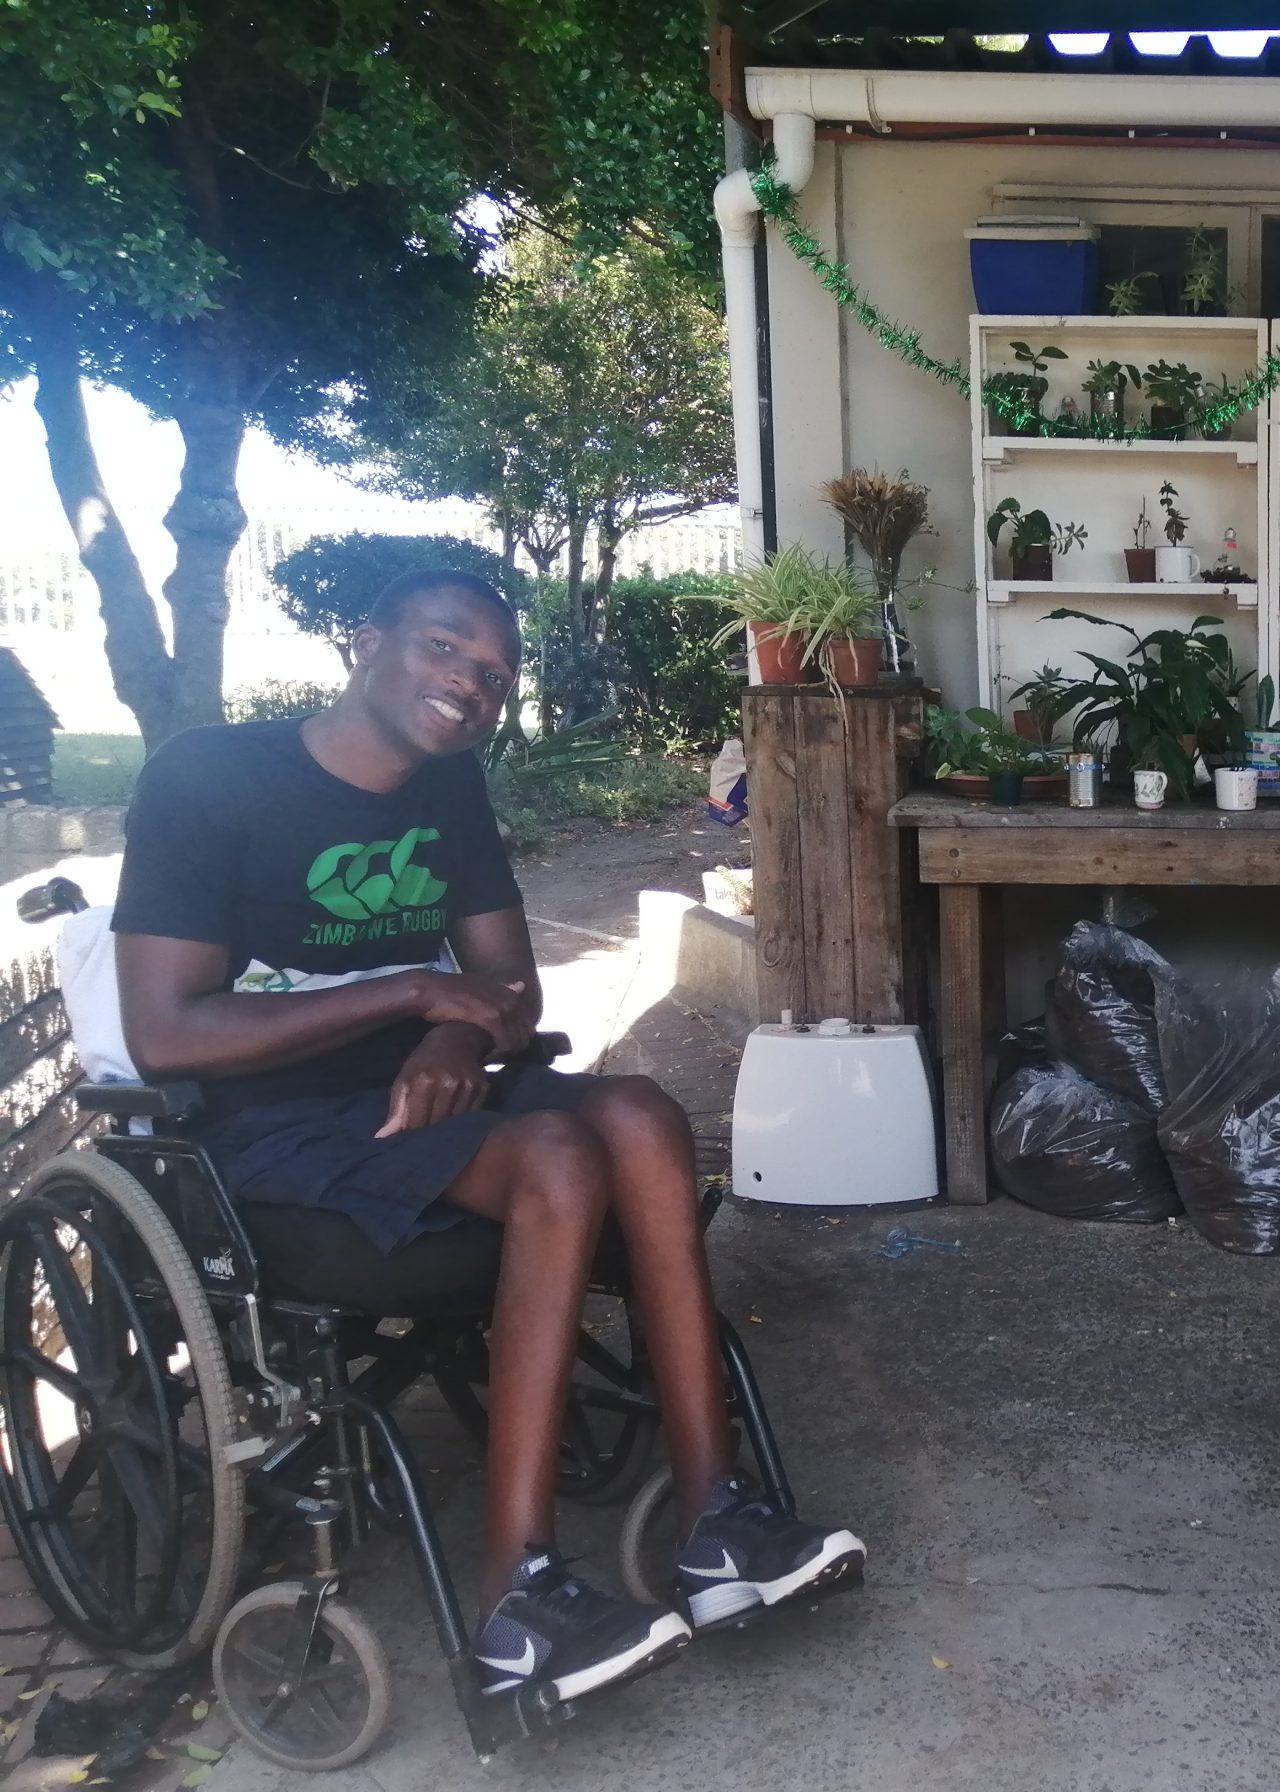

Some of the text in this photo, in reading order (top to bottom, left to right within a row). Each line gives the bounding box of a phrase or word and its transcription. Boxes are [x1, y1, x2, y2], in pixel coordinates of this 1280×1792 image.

[302, 908, 448, 946] ZIMBWE RUGBY
[203, 1256, 235, 1276] KARMA
[528, 1554, 550, 1575] NIKE
